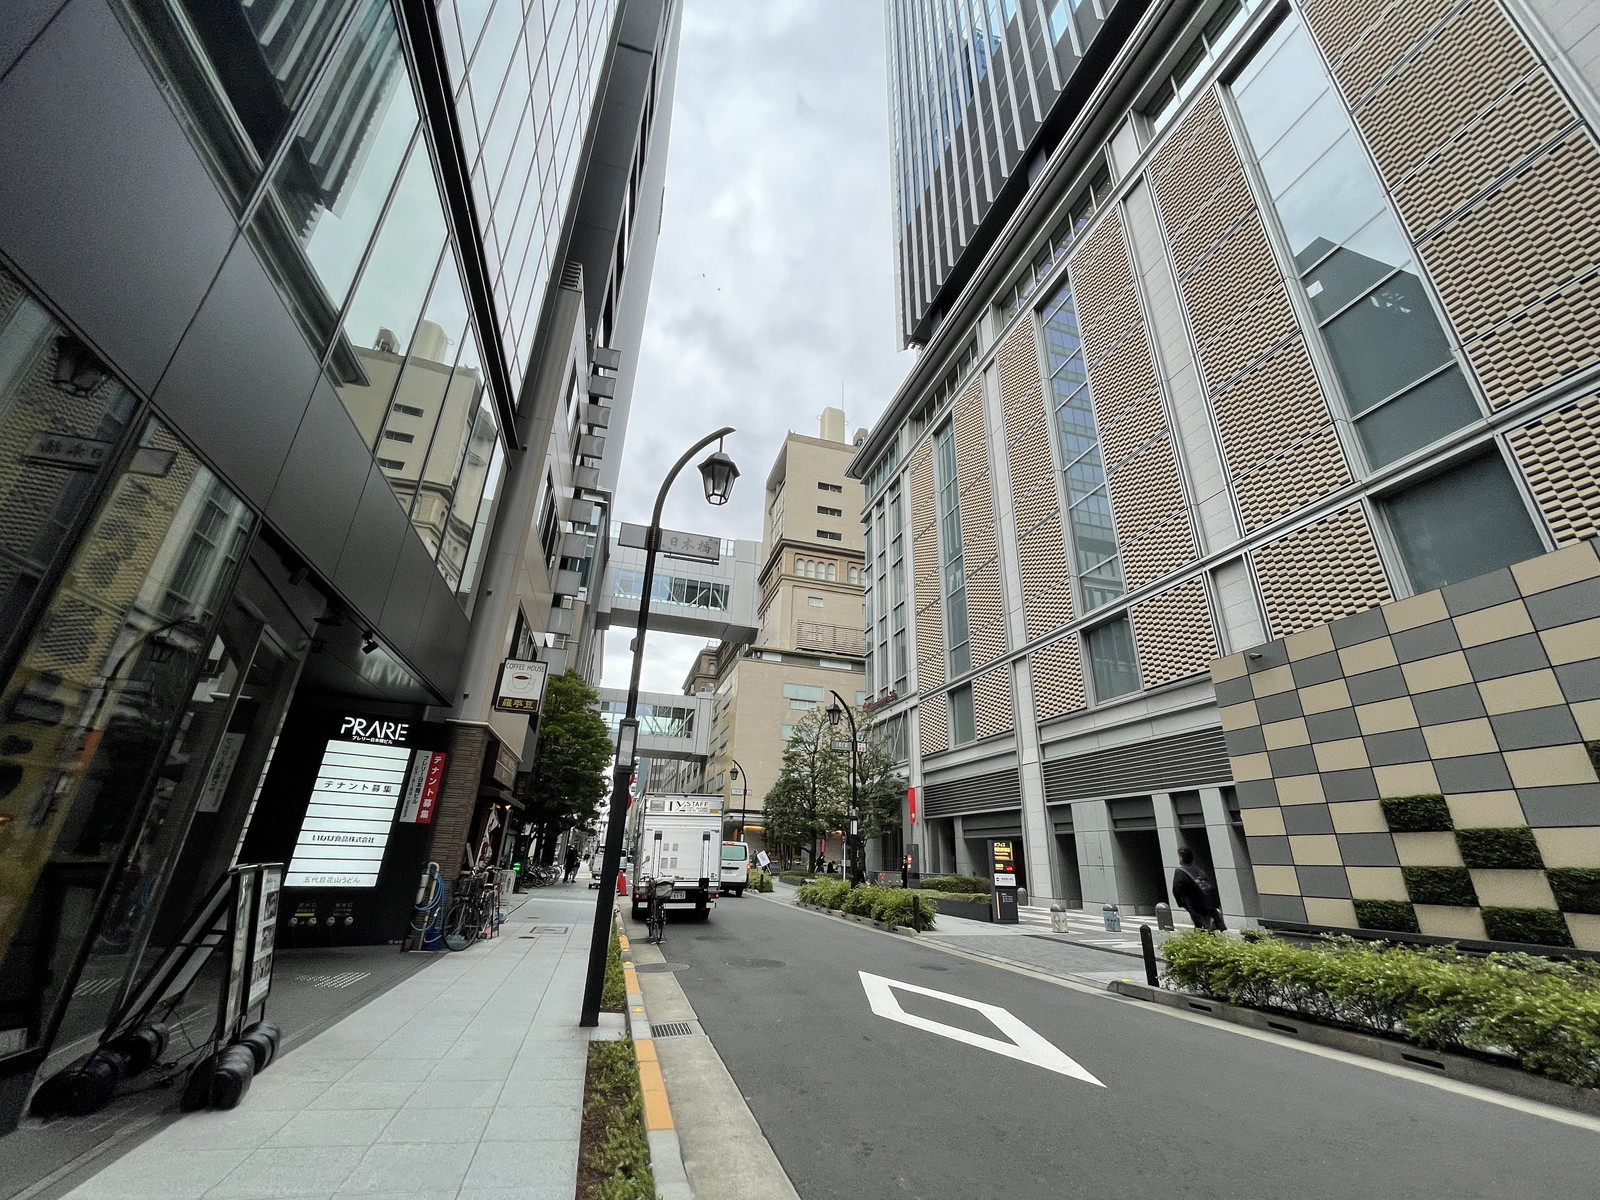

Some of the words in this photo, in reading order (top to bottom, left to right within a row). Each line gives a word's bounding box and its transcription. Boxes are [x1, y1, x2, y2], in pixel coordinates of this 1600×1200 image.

[670, 537, 712, 554] 日本橋
[505, 662, 525, 671] COFFEE
[527, 664, 545, 673] HOUSE
[340, 716, 410, 741] PRARE
[324, 780, 392, 793] テナント募集
[420, 756, 442, 819] テナント募集
[302, 876, 361, 884] 五代目花山うどん
